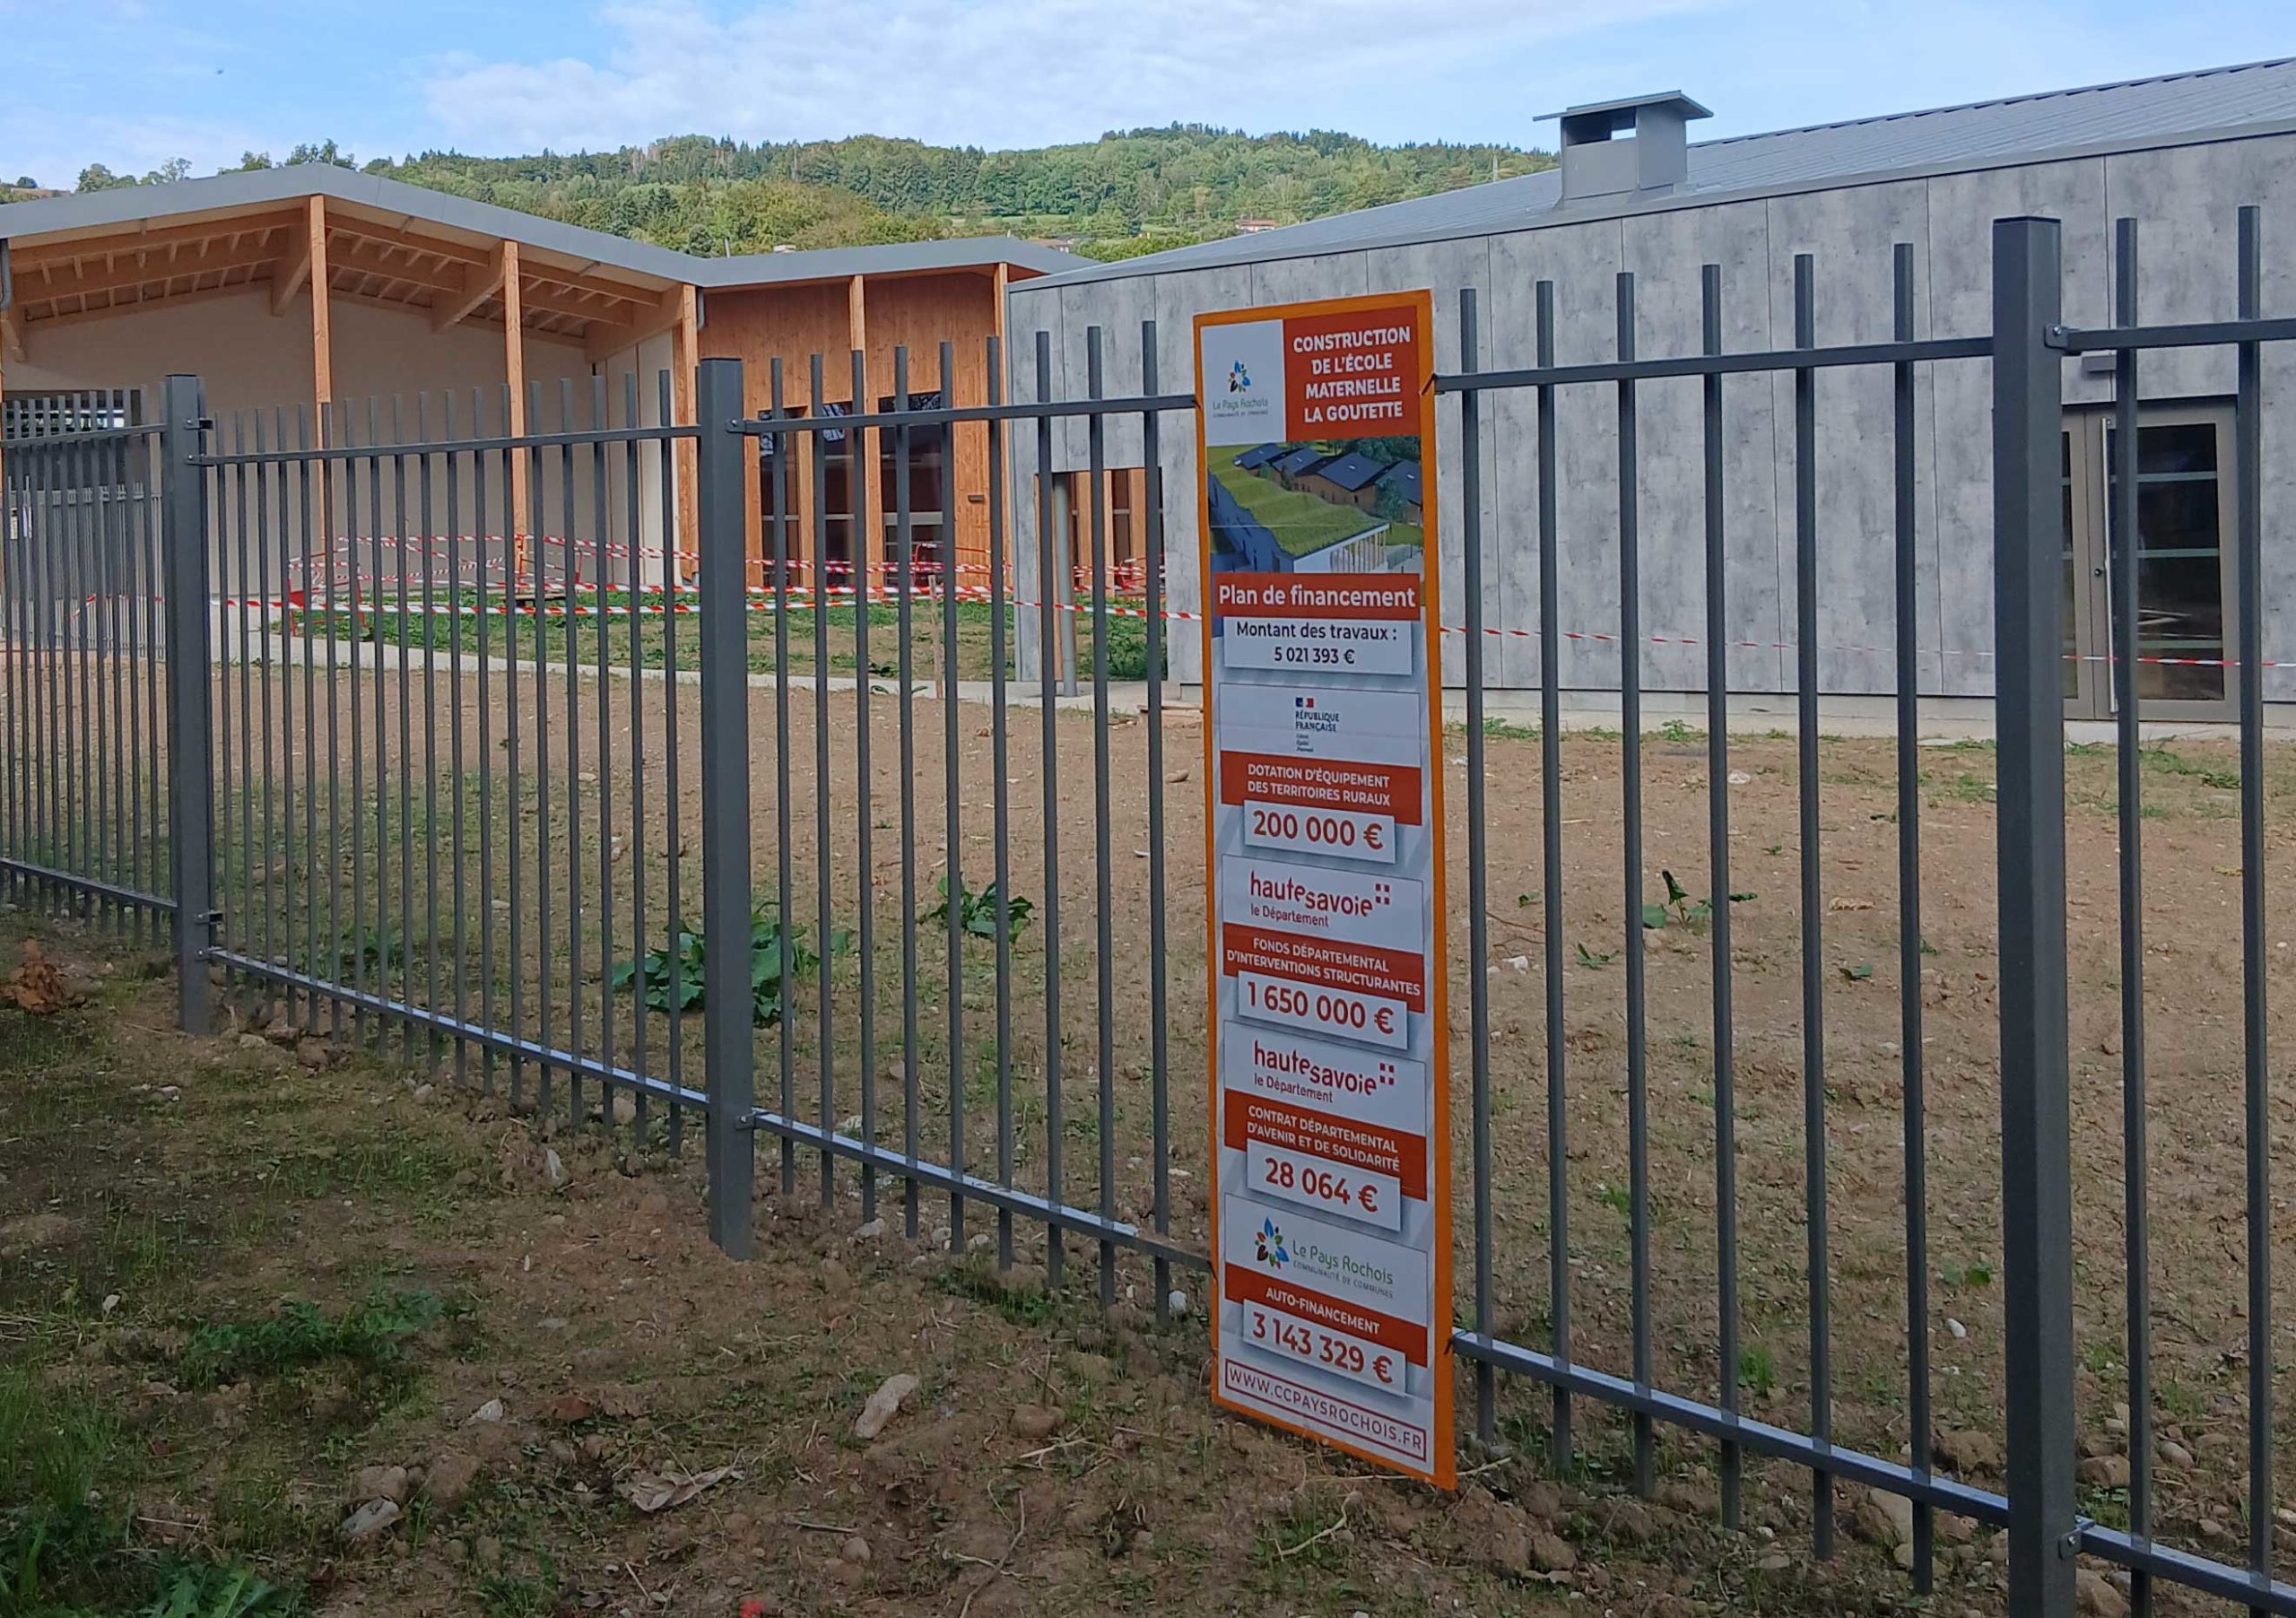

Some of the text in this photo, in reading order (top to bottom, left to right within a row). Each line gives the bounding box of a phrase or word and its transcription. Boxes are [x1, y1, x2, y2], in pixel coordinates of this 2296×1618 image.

[1293, 326, 1411, 352] CONSTRUCTION
[1312, 352, 1392, 375] DE L'ÉCOLE
[1306, 377, 1401, 399] MATERNELLE
[1304, 401, 1403, 422] LA GOUTETTE
[1219, 585, 1415, 607] Plan de financement
[1237, 622, 1296, 638] Montant
[1300, 622, 1326, 639] des
[1331, 624, 1388, 640] travaux
[1274, 647, 1355, 665] 5 021 393 €
[1295, 709, 1340, 722] RÉPUBLIQUE
[1295, 721, 1336, 732] FRANÇAISE
[1248, 763, 1390, 788] DOTATION D'ÉQUIPEMENT
[1248, 780, 1390, 806] DES TERRITOIRES RURAUX
[1253, 810, 1384, 850] 200 000 €
[1250, 904, 1329, 927] le Département
[1253, 937, 1390, 973] FONDS DÉPARTEMENTAL
[1227, 950, 1421, 996] D'INTERVENTIONS STRUCTURANTES
[1248, 981, 1394, 1034] 1 650 000 €
[1254, 1073, 1333, 1103] le Département
[1248, 1105, 1398, 1153] CONTRAT DÉPARTEMENTAL
[1248, 1122, 1400, 1172] D'AVENIR ET DE SOLIDARITÉ
[1265, 1157, 1378, 1213] 28 064 €
[1292, 1240, 1394, 1285] Le Pays Rochois
[1265, 1287, 1380, 1335] AUTO-FINANCEMENT
[1252, 1311, 1393, 1384] 3 143 329 €
[1229, 1368, 1422, 1450] WWW.CCPAYSROCHOIS.FR
